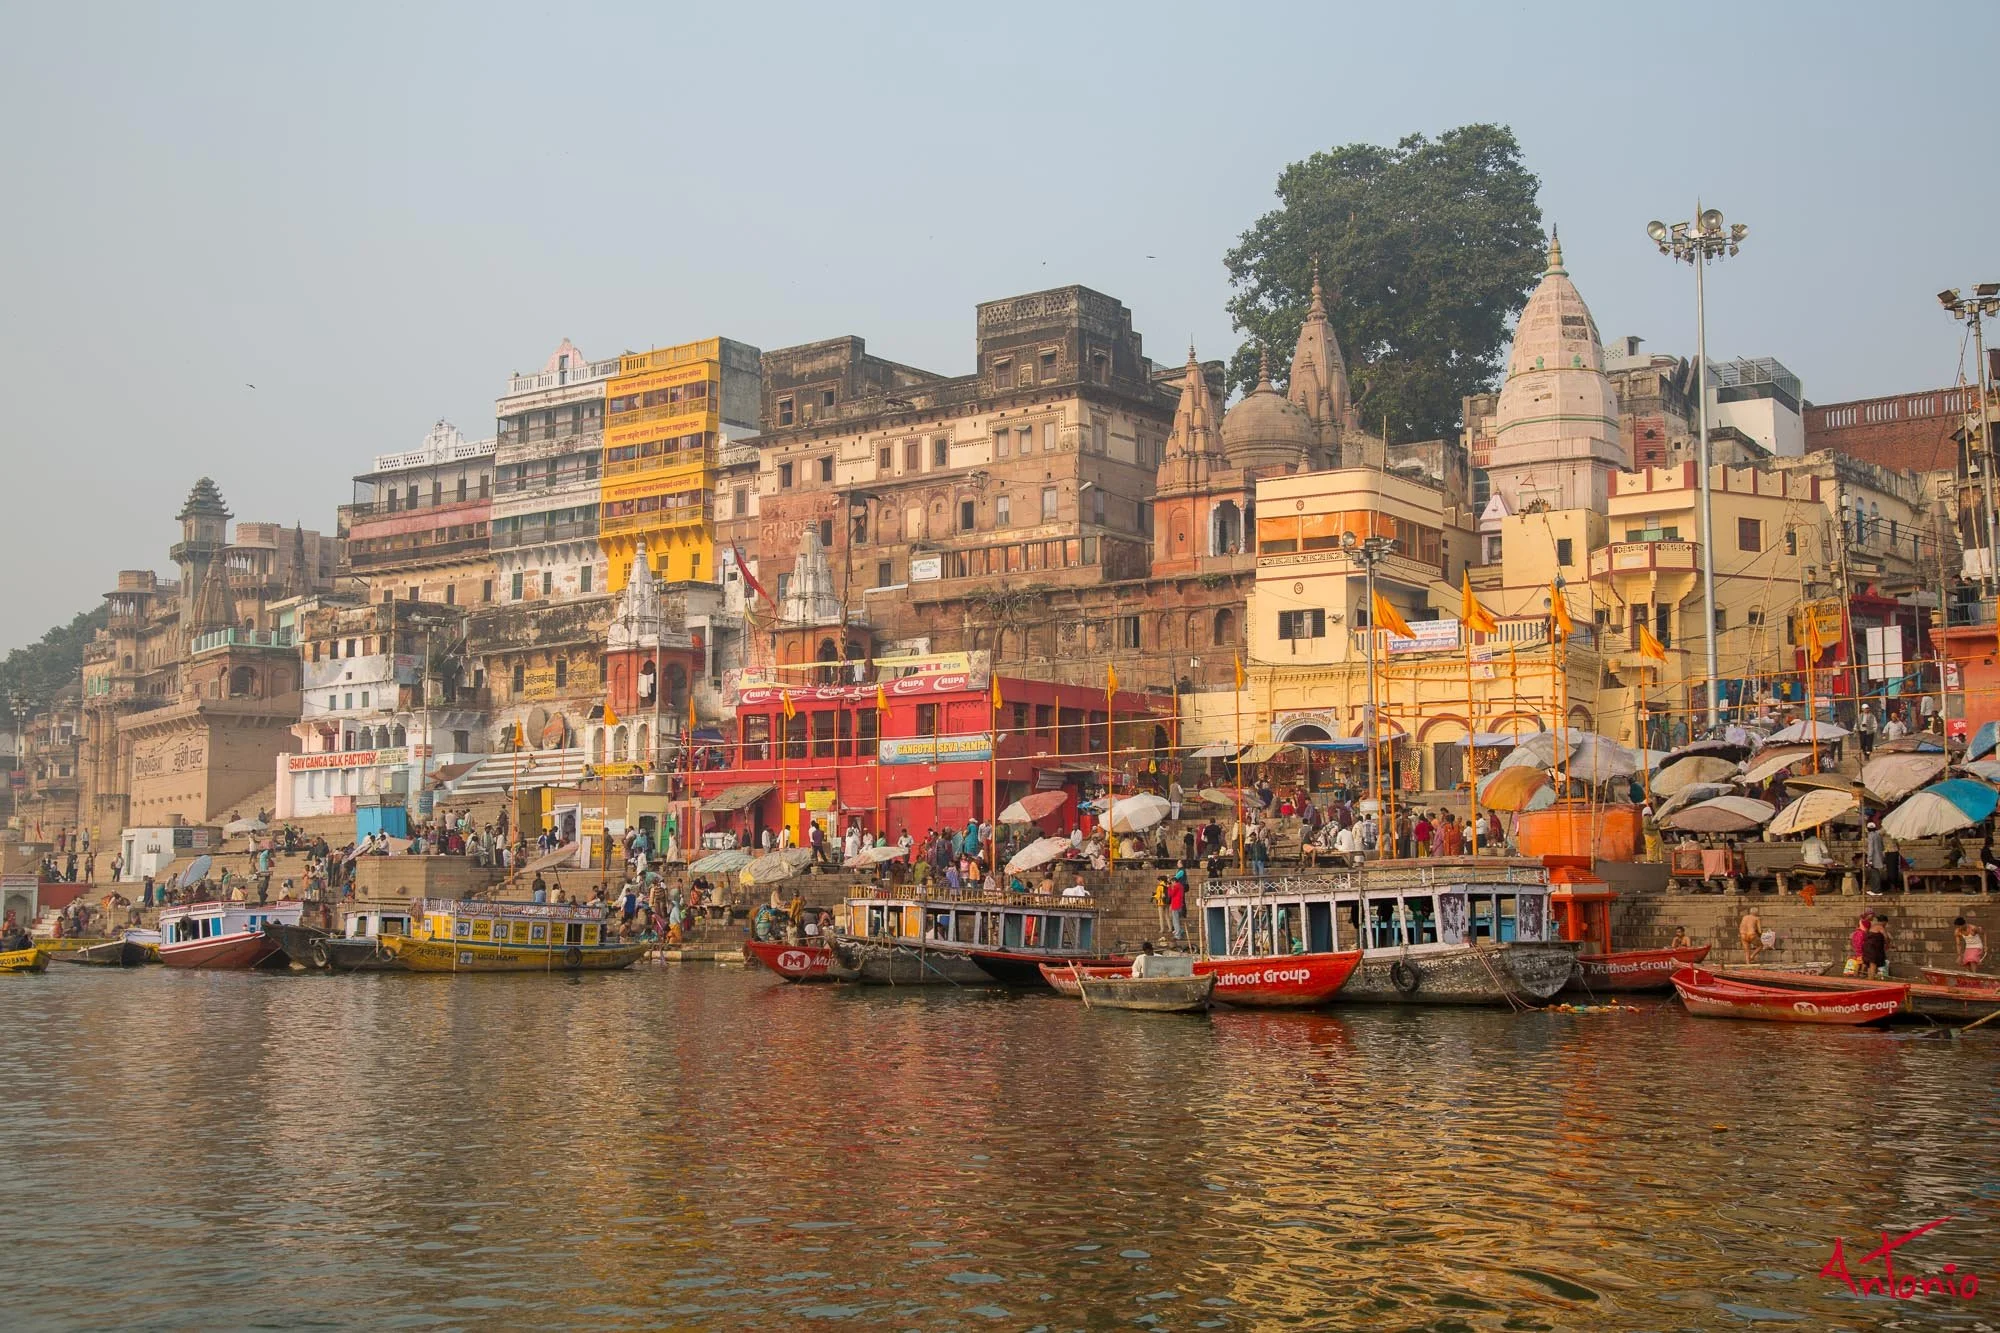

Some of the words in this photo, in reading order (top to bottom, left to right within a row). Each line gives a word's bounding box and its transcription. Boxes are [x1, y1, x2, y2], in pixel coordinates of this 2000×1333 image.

[938, 741, 958, 753] SEVA
[960, 739, 990, 752] SAMITI
[190, 749, 203, 765] घाट
[289, 755, 305, 770] SHIV
[305, 755, 328, 768] GANGA
[328, 754, 343, 767] SILK
[344, 752, 377, 766] FACTORY
[477, 953, 495, 961] UCO
[497, 953, 519, 961] BANK
[1590, 961, 1639, 975] Muthoot
[1214, 971, 1260, 986] uthoot
[1263, 968, 1310, 984] Group
[1821, 1003, 1860, 1014] Muthoot
[1861, 1000, 1898, 1014] Group
